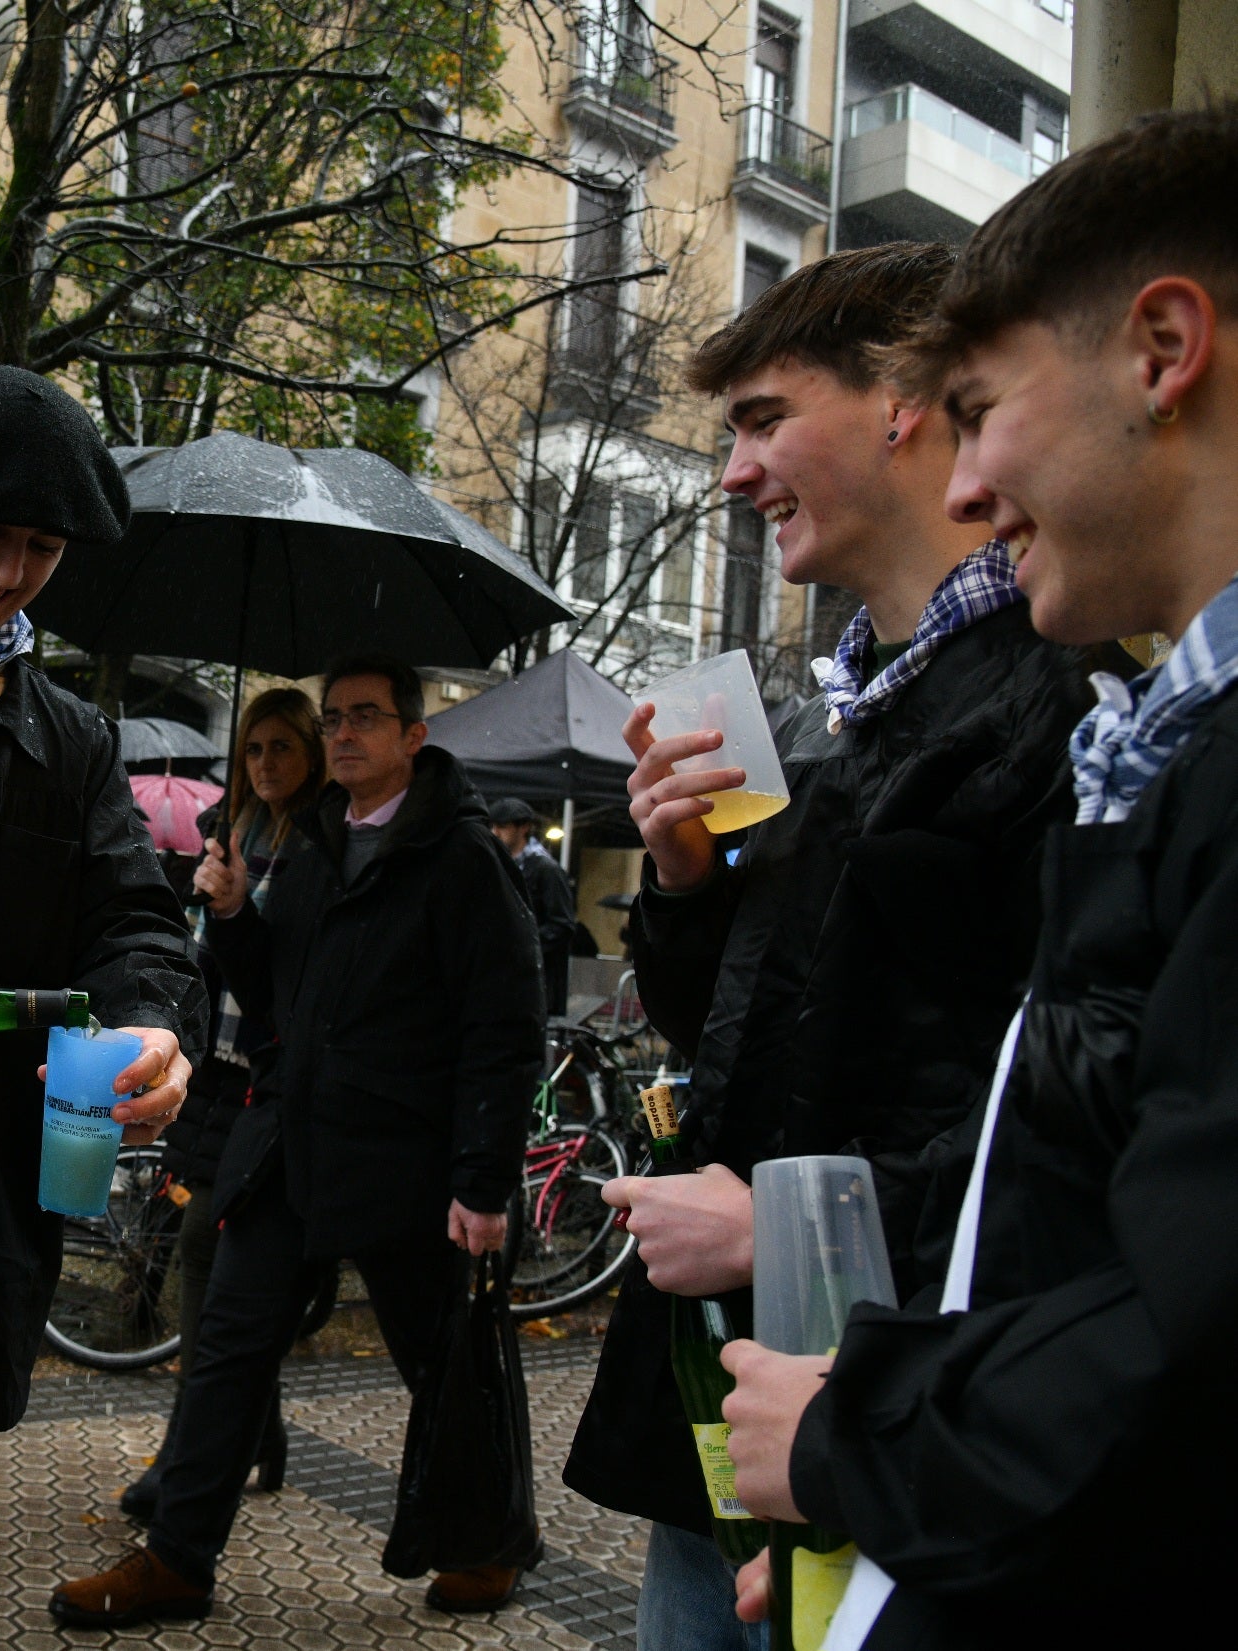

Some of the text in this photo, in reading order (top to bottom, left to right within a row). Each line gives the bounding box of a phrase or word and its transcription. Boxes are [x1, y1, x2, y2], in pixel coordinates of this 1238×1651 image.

[57, 1105, 90, 1117] SEBASTIÁN
[666, 1102, 677, 1129] Sidra
[59, 1127, 113, 1140] FIESTAS SOSTENIBLES
[75, 1125, 101, 1133] GARBIAK
